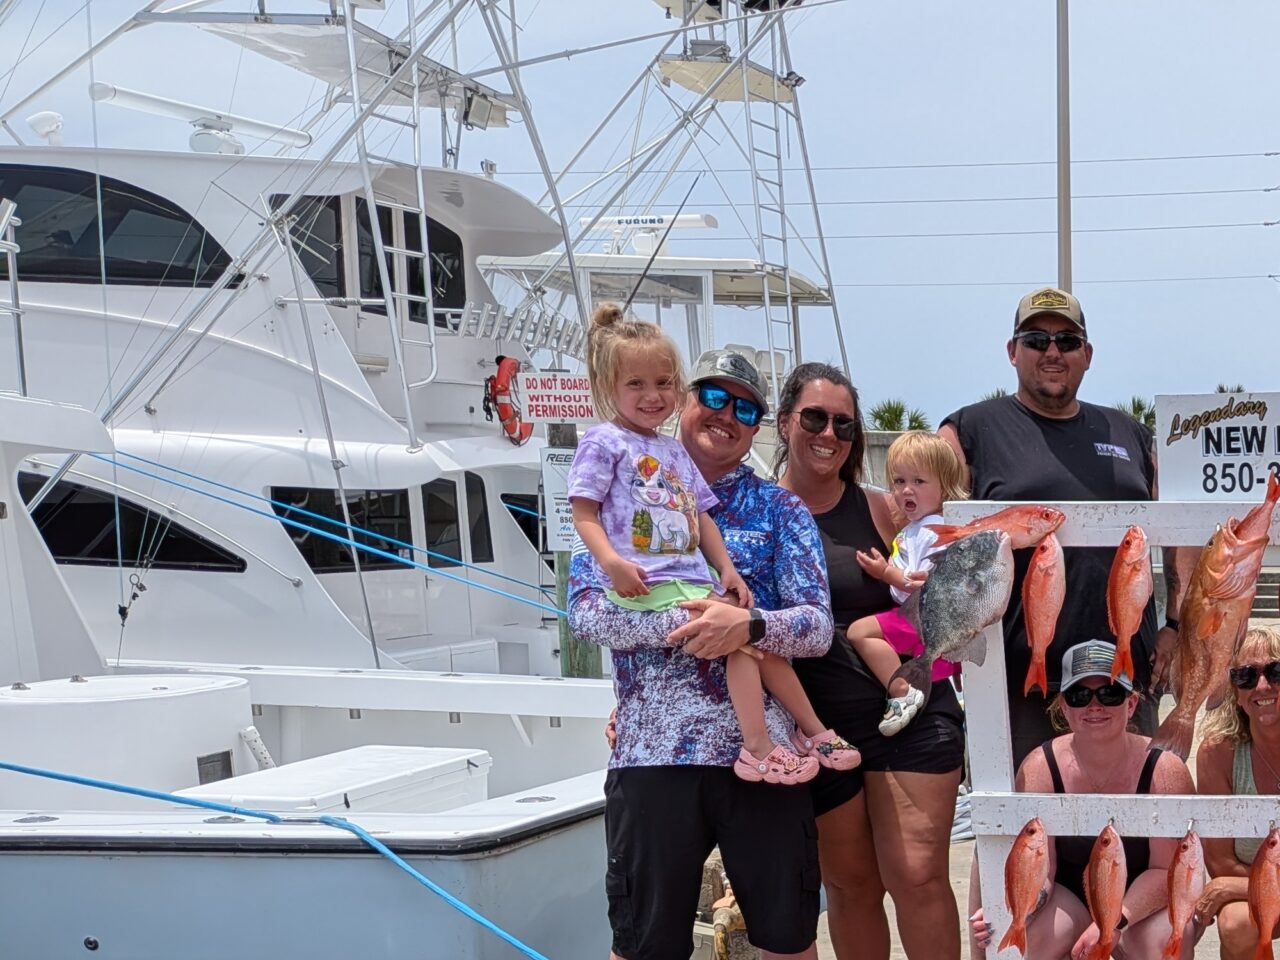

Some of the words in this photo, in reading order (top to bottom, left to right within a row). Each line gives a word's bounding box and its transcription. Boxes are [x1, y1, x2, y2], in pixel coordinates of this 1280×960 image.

[525, 378, 538, 390] DO
[540, 378, 557, 390] NOT
[560, 378, 590, 391] BOARD
[528, 394, 590, 403] WITHOUT
[528, 404, 594, 418] PERMISSION
[1166, 397, 1268, 446] Legendary
[1203, 425, 1267, 456] NEW
[546, 454, 575, 463] REE
